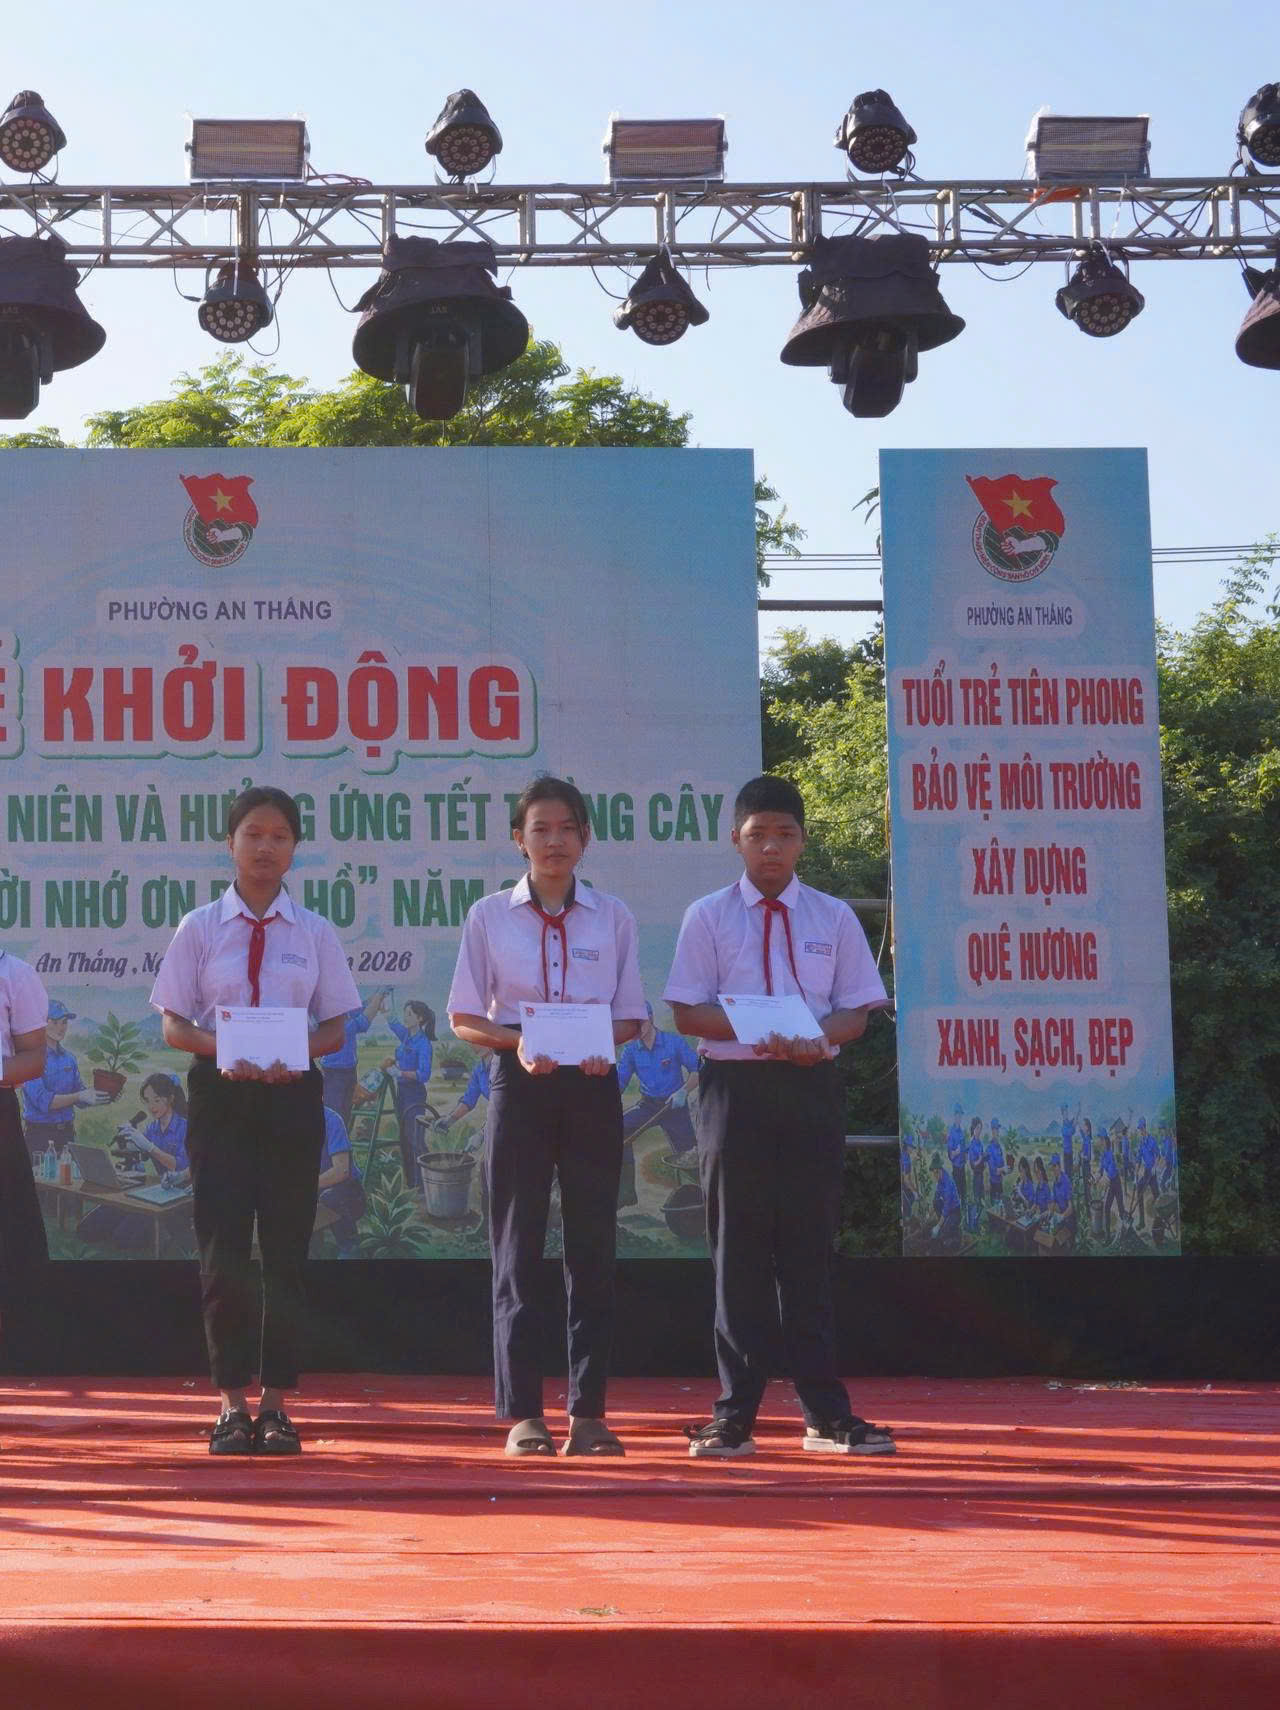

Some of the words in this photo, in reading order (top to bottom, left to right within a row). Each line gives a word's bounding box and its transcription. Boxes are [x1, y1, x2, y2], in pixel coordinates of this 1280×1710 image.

[108, 596, 208, 621] PHƯỜNG
[215, 601, 246, 621] AN
[967, 601, 1014, 626] PHƯỜNG
[1017, 606, 1032, 625] AN
[43, 644, 246, 742] KHỞI
[281, 650, 520, 758] ĐỘNG
[902, 660, 954, 726] TUỔI
[959, 662, 1002, 726] TRẺ
[1007, 668, 1059, 726] TIÊN
[1065, 677, 1144, 726] PHONG
[8, 783, 102, 843] NIÊN
[116, 791, 167, 842] VÀ
[329, 783, 411, 842] ỨNG
[423, 777, 491, 841] TẾT
[649, 782, 724, 841] CÂY
[911, 747, 957, 811] BẢO
[964, 753, 992, 820] VỆ
[999, 752, 1043, 810] MÔI
[1049, 751, 1141, 810] TRƯỜNG
[46, 869, 128, 929] NHỚ
[142, 875, 196, 928] ƠN
[393, 868, 485, 927] NĂM
[972, 837, 1016, 895] XÂY
[1023, 842, 1087, 906] DỰNG
[35, 952, 61, 973] An
[358, 950, 413, 972] 2026
[967, 922, 1012, 987] QUÊ
[1019, 927, 1097, 981] HƯƠNG
[936, 1018, 1007, 1073] XANH,
[1013, 1017, 1082, 1077] SẠCH,
[1088, 1018, 1134, 1077] ĐẸP
